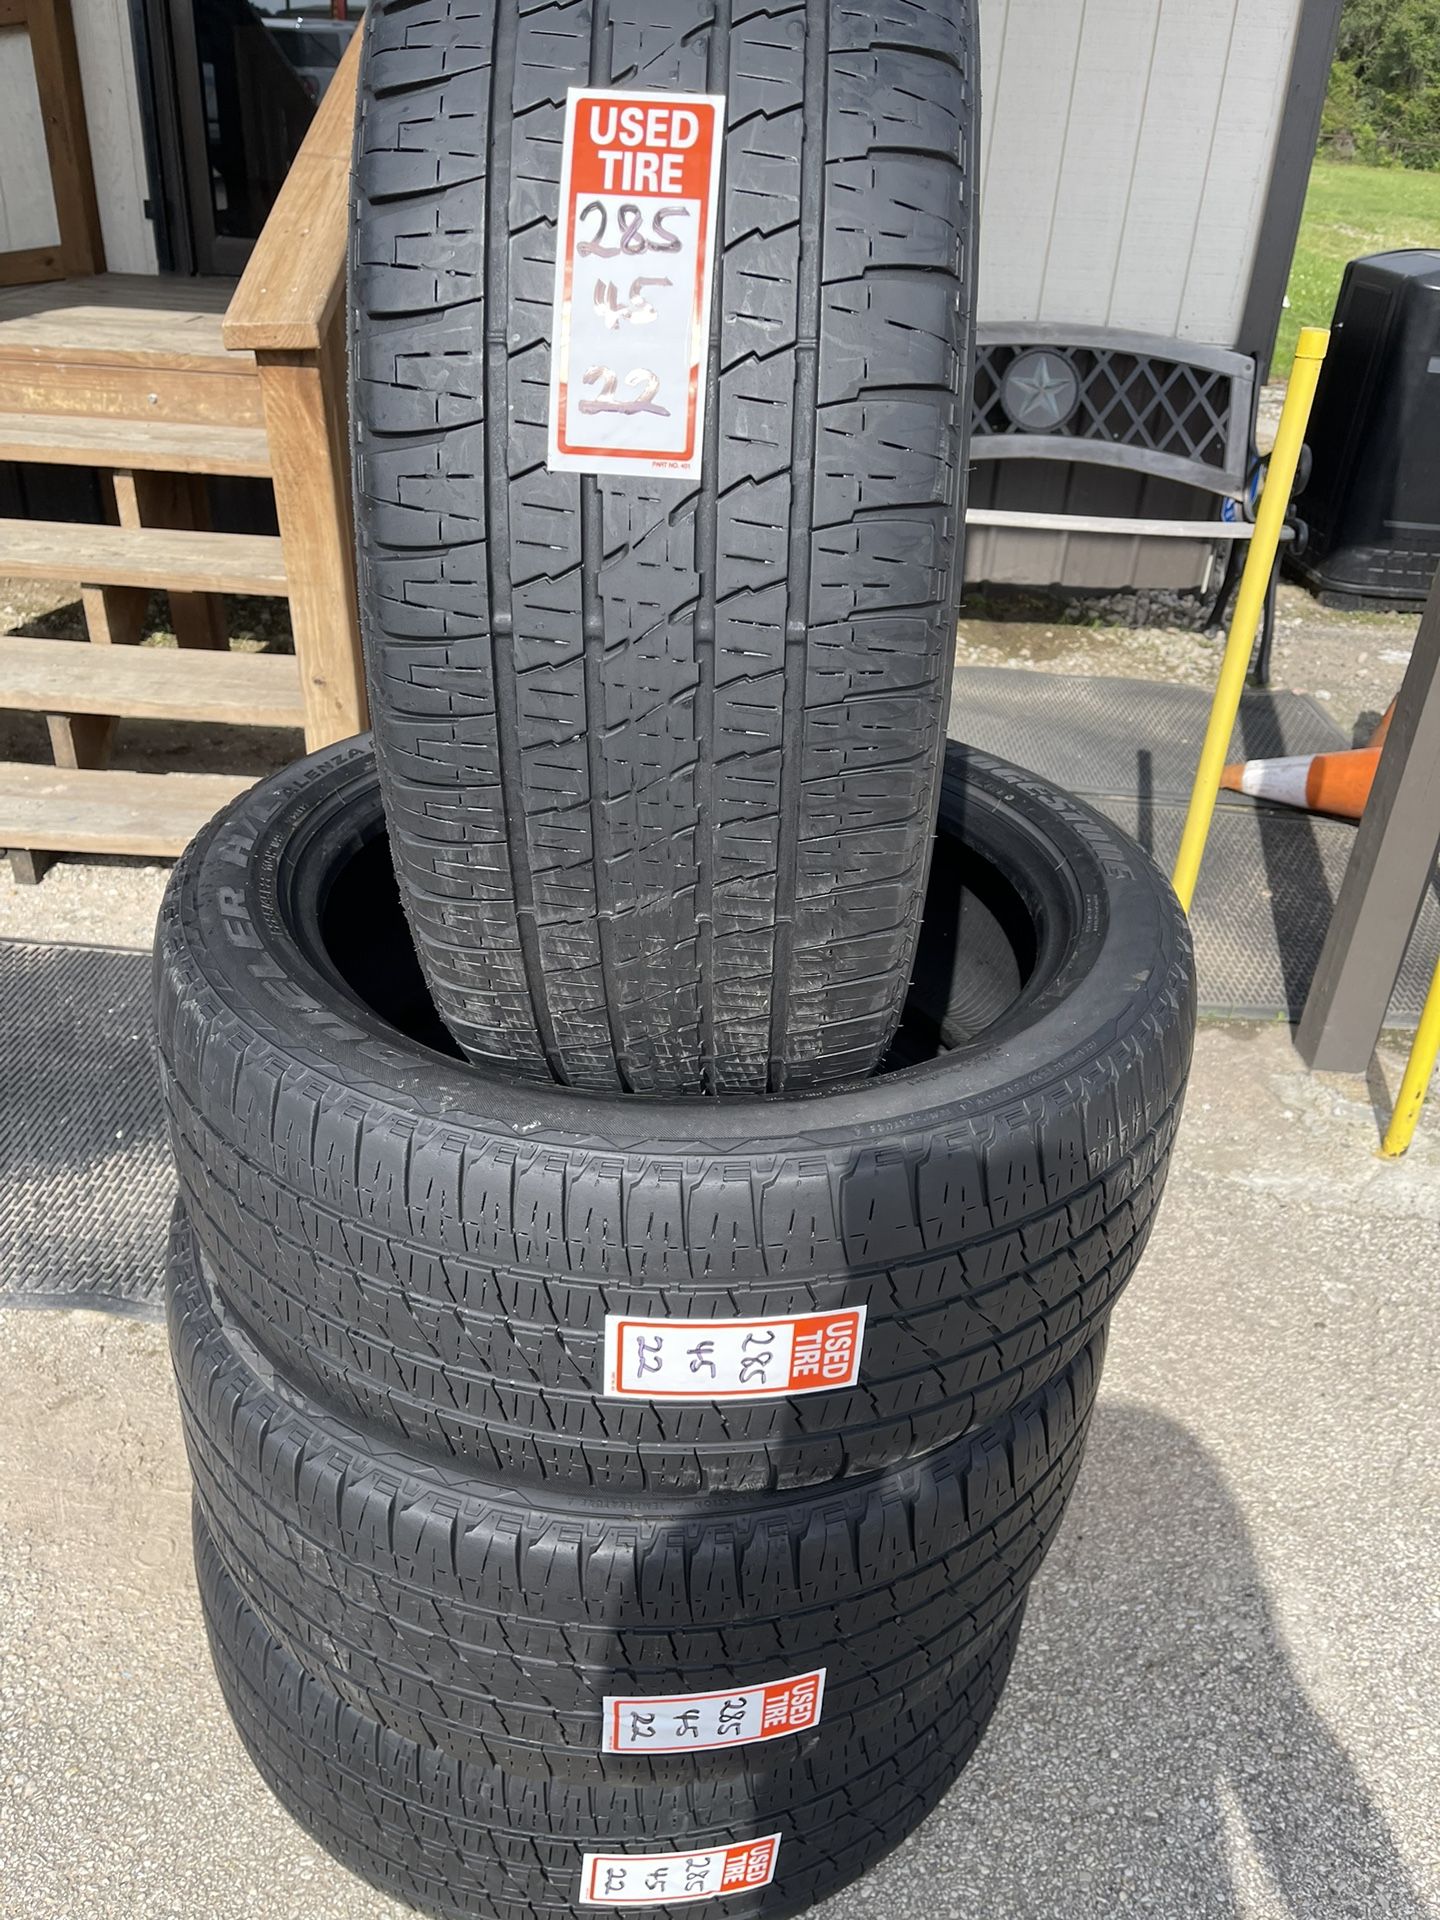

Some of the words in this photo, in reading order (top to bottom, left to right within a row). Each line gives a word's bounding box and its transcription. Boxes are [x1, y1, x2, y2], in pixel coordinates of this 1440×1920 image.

[589, 106, 699, 149] USED
[597, 150, 684, 193] TIRE
[576, 200, 690, 258] 285
[594, 276, 673, 330] 45
[578, 365, 671, 417] 22
[281, 748, 365, 799] ALENZA
[217, 886, 434, 1069] DUELER
[637, 1336, 664, 1378] 22
[687, 1341, 716, 1379] 45
[739, 1331, 775, 1384] 285
[792, 1329, 823, 1378] TIRE
[823, 1320, 854, 1379] USED
[673, 1709, 699, 1737] 45
[718, 1697, 747, 1735] 285
[764, 1692, 790, 1728] TIRE
[789, 1680, 815, 1725] USED
[630, 1711, 656, 1741] 22
[605, 1867, 627, 1895] 22
[645, 1867, 669, 1892] 45
[684, 1857, 711, 1891] 285
[723, 1852, 748, 1885] TIRE
[746, 1843, 771, 1882] USED
